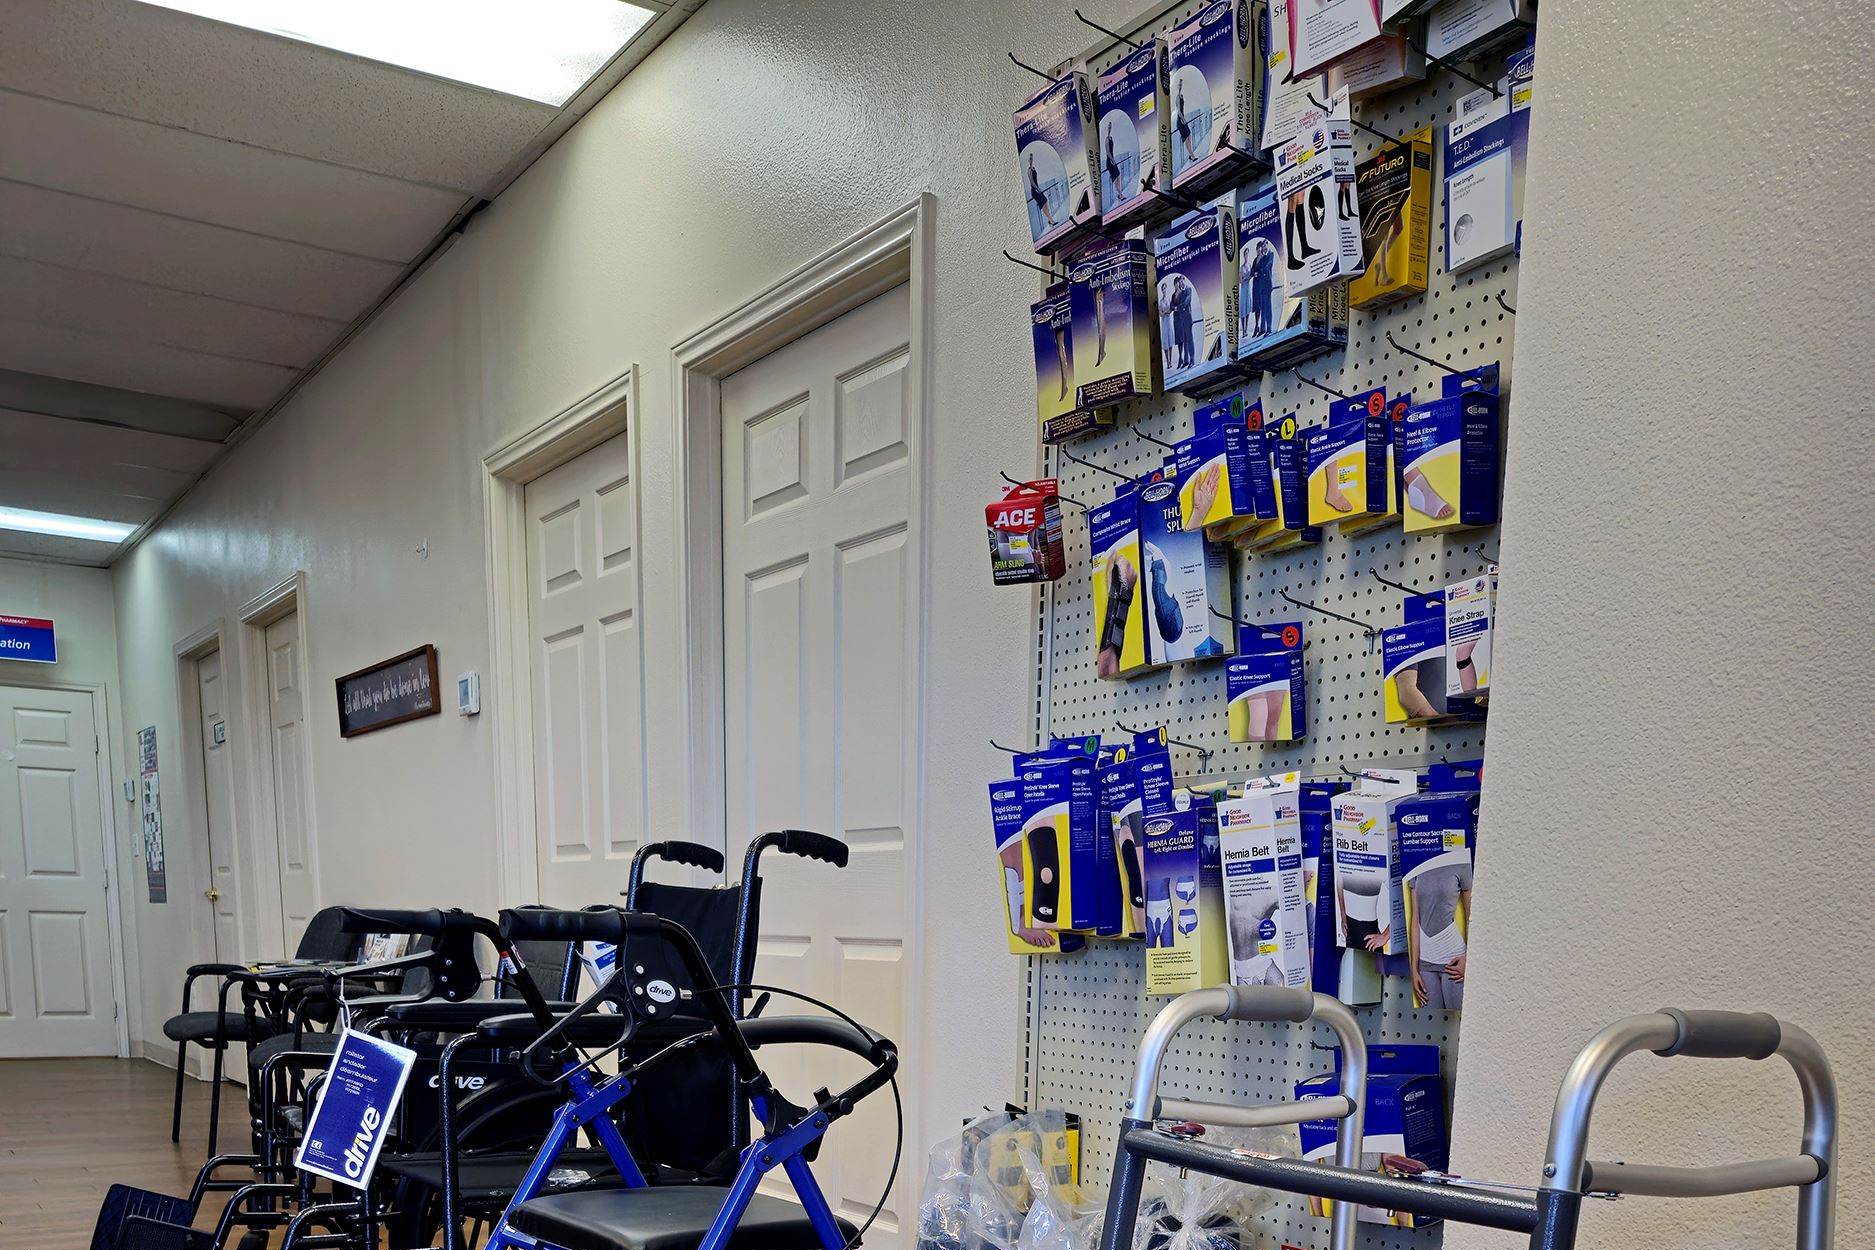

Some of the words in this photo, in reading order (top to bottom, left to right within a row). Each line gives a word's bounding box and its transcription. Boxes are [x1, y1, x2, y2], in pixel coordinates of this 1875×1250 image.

[1369, 156, 1405, 178] FUTURO
[1280, 173, 1303, 192] Medical
[1303, 163, 1324, 181] Socks
[1241, 207, 1276, 232] Microfiber
[1156, 245, 1190, 268] Microfiber
[994, 508, 1036, 528] ACE
[994, 561, 1007, 570] ARM
[1008, 559, 1025, 568] SLING
[1448, 615, 1465, 625] Knee
[1465, 609, 1485, 622] Strap
[1286, 630, 1295, 643] S
[0, 639, 30, 650] ation
[1147, 840, 1168, 850] HERNIA
[1168, 836, 1194, 846] GUARD
[1277, 837, 1296, 846] Hernia
[1336, 838, 1350, 850] Rib
[1351, 840, 1369, 852] Belt
[1224, 849, 1250, 860] Hernia
[1251, 846, 1270, 857] Belt
[1277, 845, 1290, 854] Belt
[650, 985, 673, 998] drive
[345, 1050, 365, 1061] rollator
[345, 1106, 380, 1178] drive
